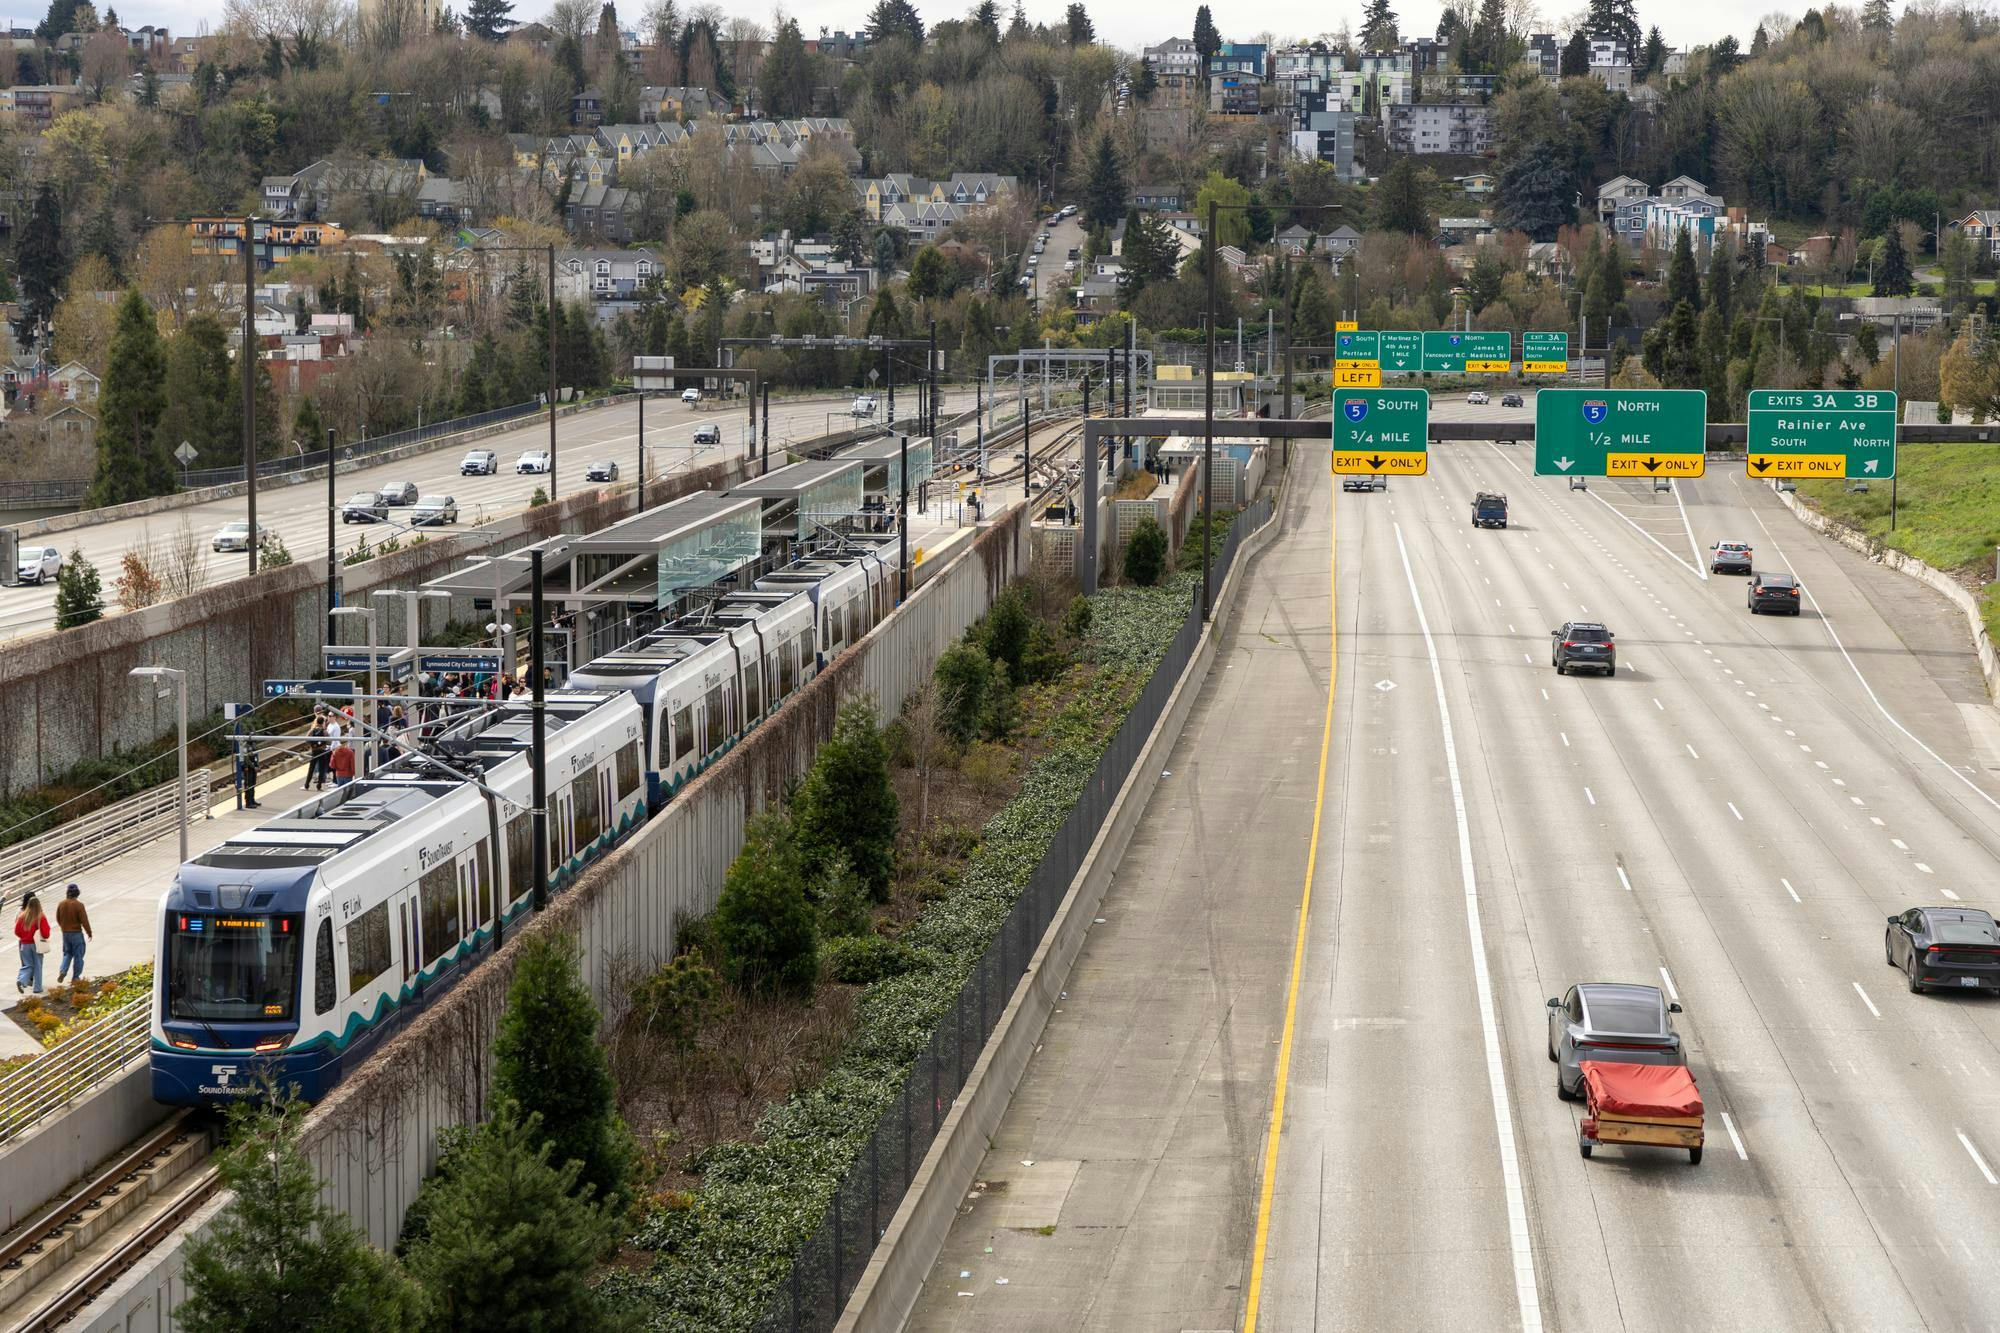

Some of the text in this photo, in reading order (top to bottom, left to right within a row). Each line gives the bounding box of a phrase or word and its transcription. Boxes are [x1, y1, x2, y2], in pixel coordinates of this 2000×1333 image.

[1342, 374, 1372, 382] LEFT
[1768, 395, 1878, 408] EXITS 3A 3B
[1352, 406, 1360, 417] 5
[1377, 399, 1418, 410] SOUTH
[1591, 408, 1599, 418] 5
[1618, 400, 1660, 411] NORTH
[1778, 420, 1866, 430] Rainier Ave
[1351, 430, 1410, 443] 3/4 MILE
[1590, 432, 1650, 445] 1/2 MILE
[1771, 437, 1806, 446] SOUTH
[1854, 438, 1890, 447] NORTH
[1336, 458, 1422, 467] EXIT ONLY
[1612, 460, 1698, 470] EXIT ONLY
[1777, 462, 1841, 470] EXIT ONLY
[198, 1085, 251, 1094] SOUNDTRANS
